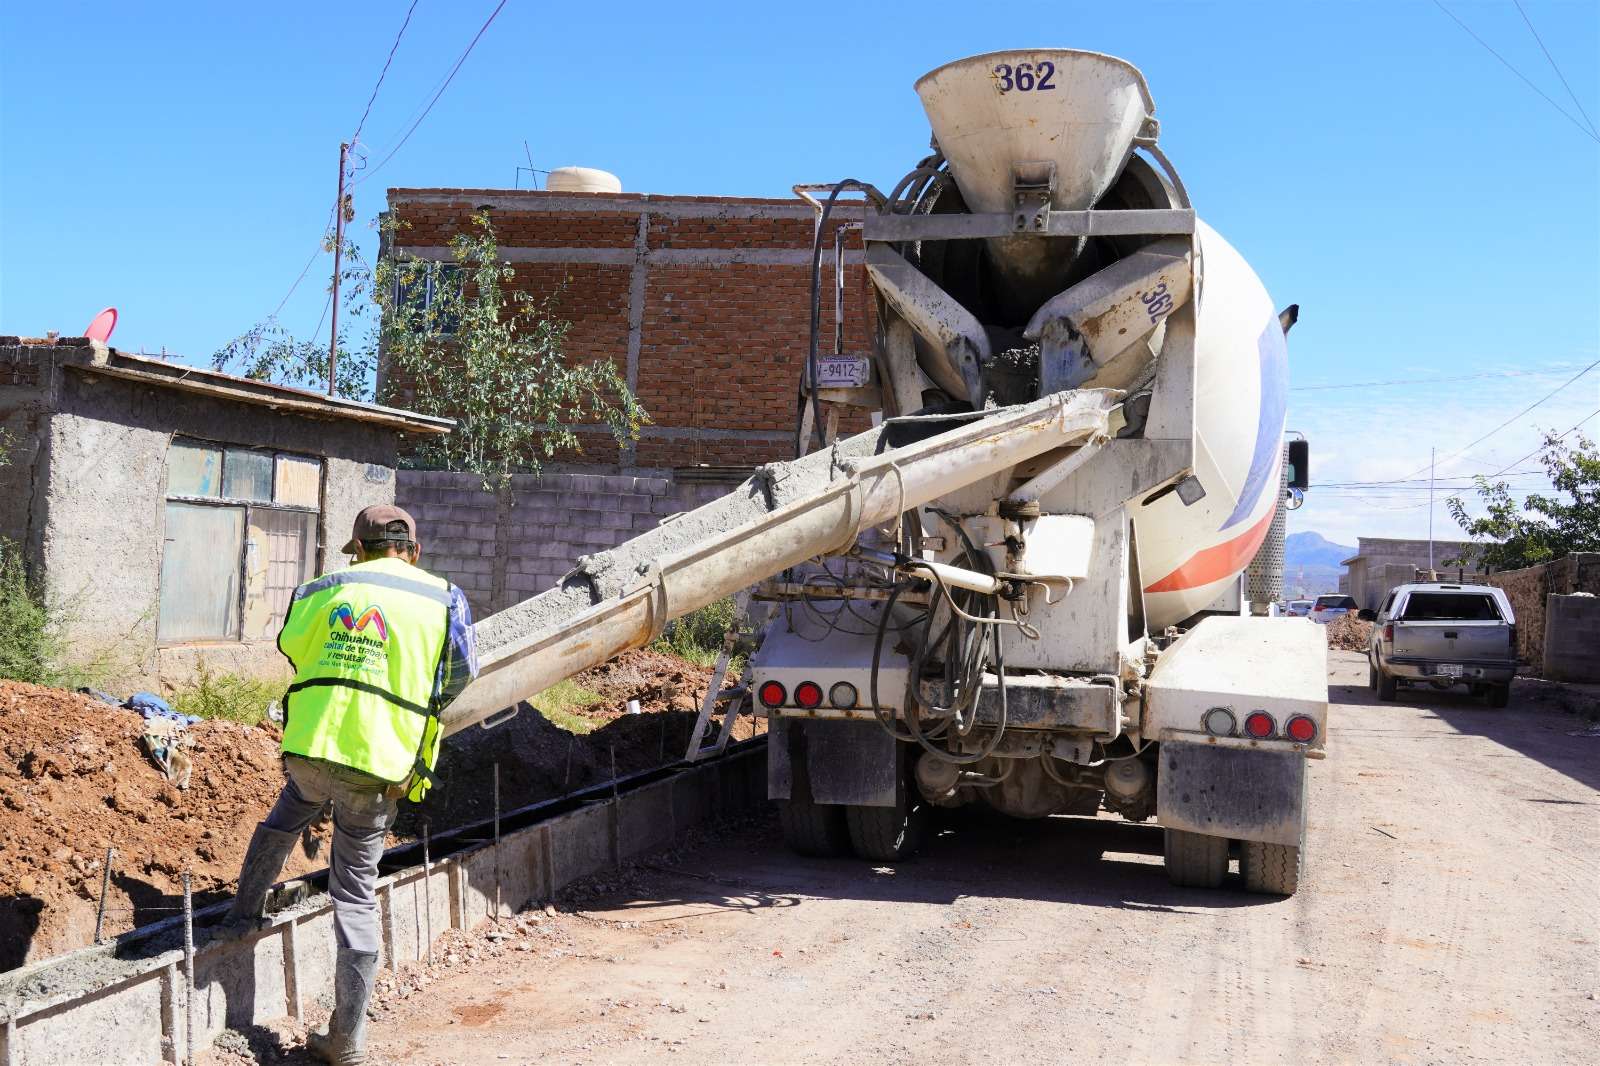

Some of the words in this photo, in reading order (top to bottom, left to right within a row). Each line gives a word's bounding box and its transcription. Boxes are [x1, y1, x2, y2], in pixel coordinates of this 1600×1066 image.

[994, 61, 1056, 92] 362
[1141, 283, 1174, 325] 362
[330, 631, 383, 648] Chihuahua
[345, 644, 355, 652] de
[332, 652, 375, 665] resultados
